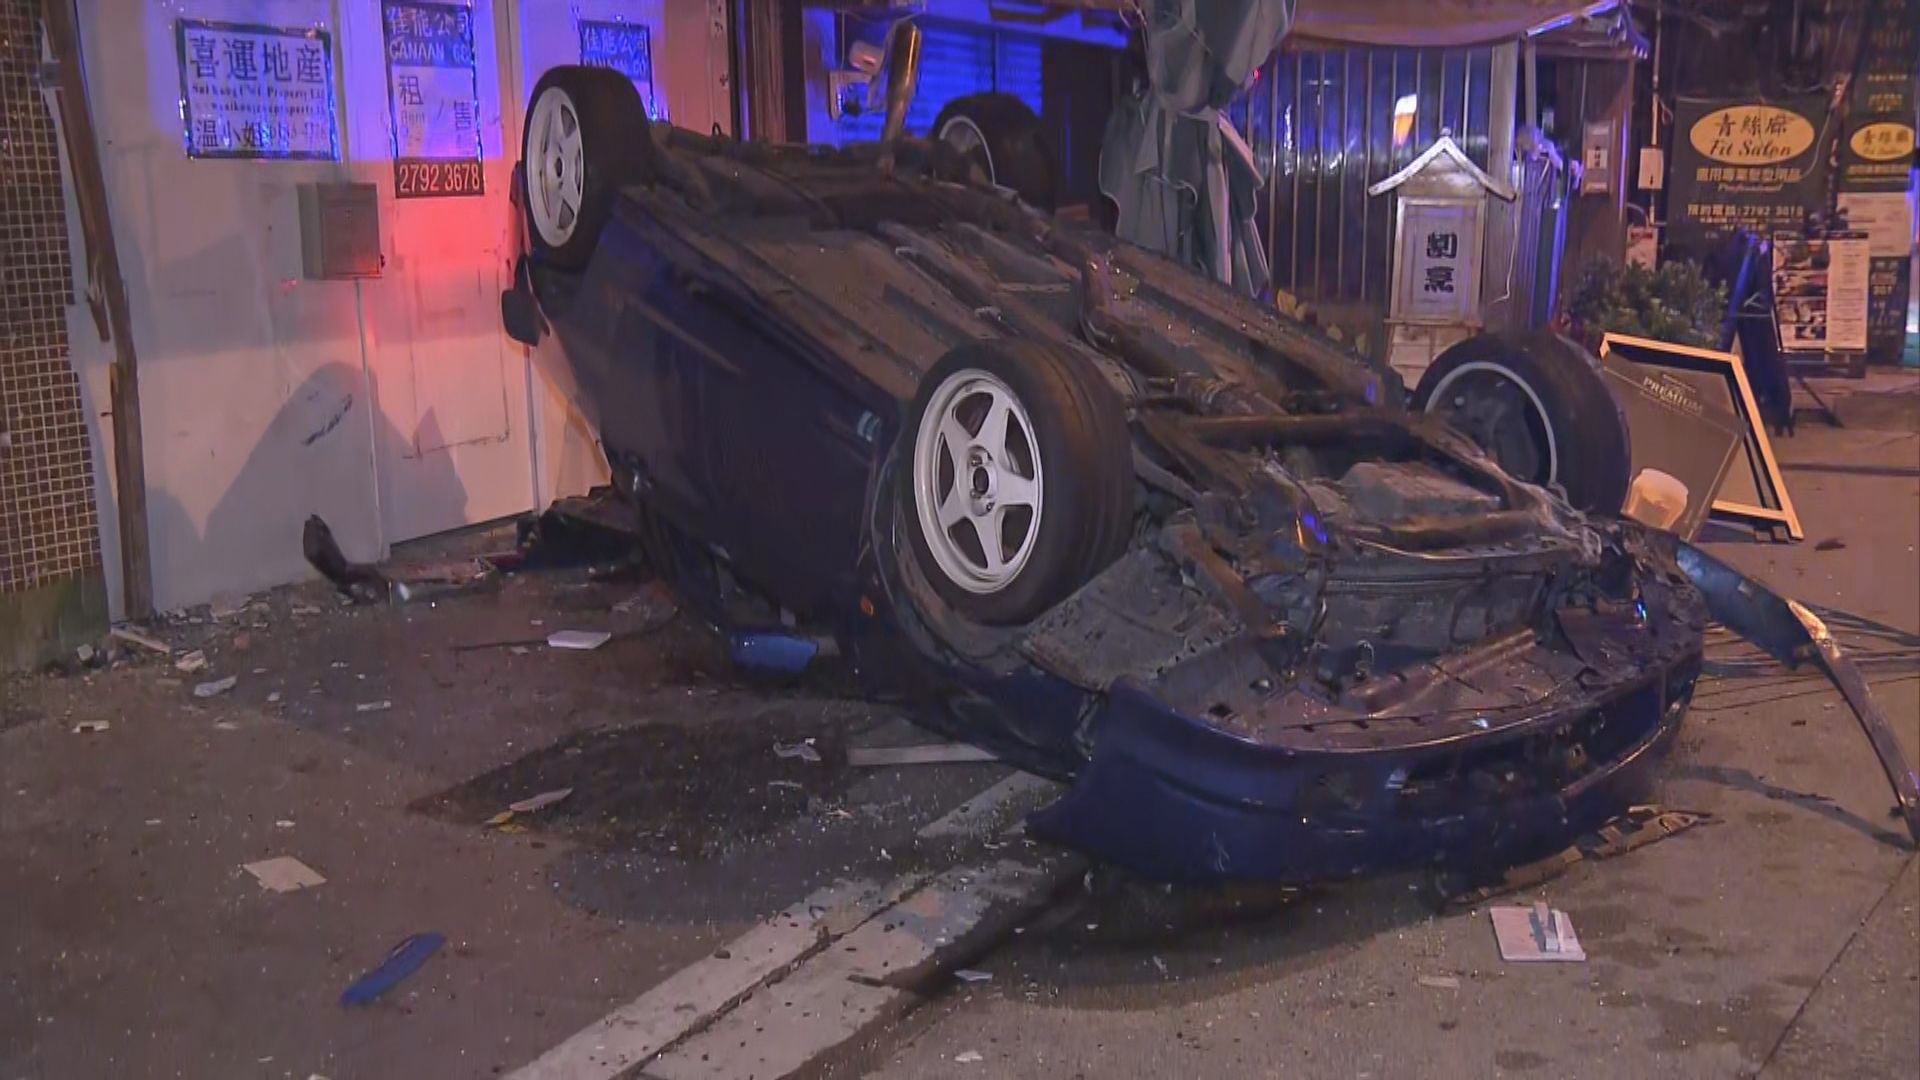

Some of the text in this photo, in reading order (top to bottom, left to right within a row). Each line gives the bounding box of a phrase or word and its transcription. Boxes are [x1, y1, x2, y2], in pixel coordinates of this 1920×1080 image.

[399, 75, 424, 105] 租
[399, 163, 481, 192] 2792 3678
